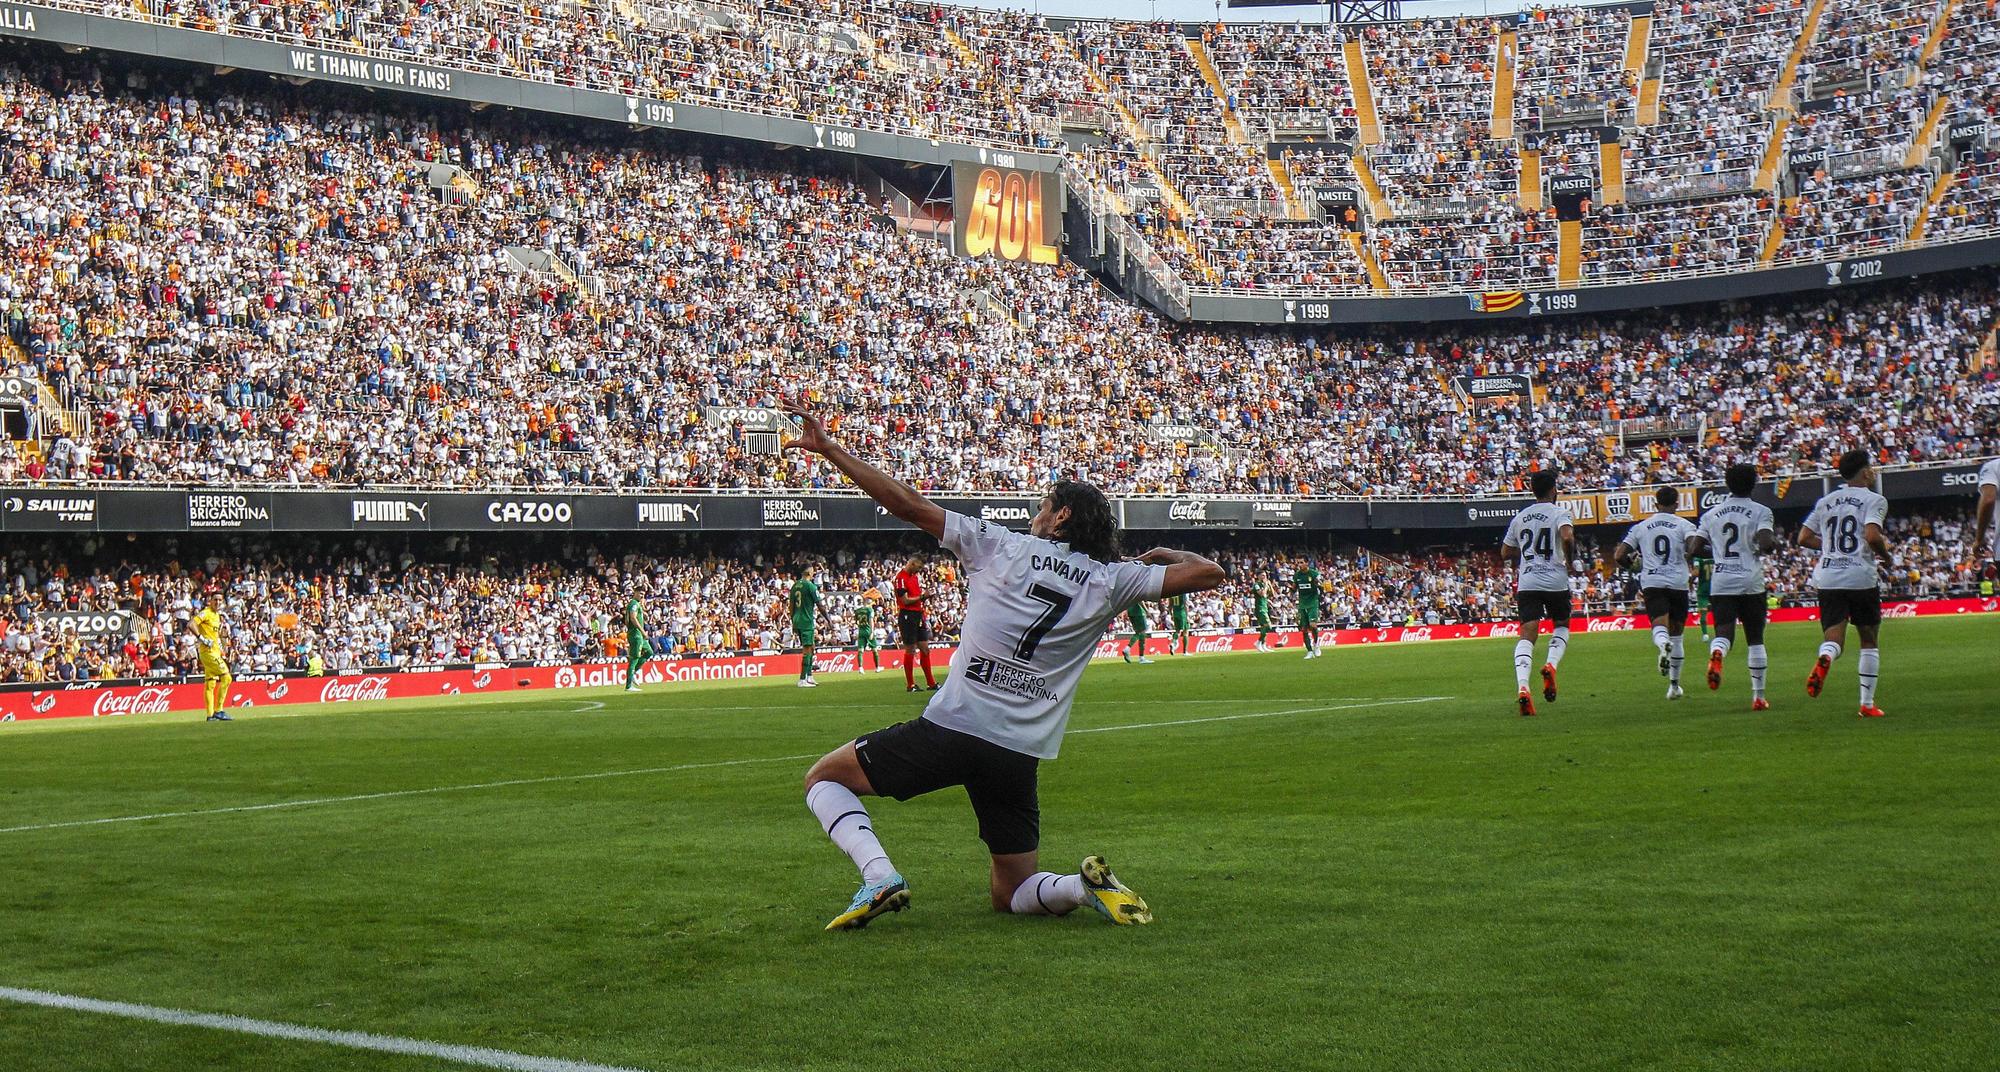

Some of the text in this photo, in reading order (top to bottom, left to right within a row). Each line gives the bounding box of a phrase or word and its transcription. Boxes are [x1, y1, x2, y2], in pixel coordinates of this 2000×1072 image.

[291, 51, 451, 91] WE THANK OUR FANS!
[645, 104, 674, 123] 1979
[830, 130, 856, 148] 1980
[1950, 124, 1985, 138] AMSTE
[992, 153, 1015, 168] 1980
[1790, 150, 1826, 164] AMSTE
[1127, 187, 1160, 198] AMSTEL
[1552, 178, 1591, 190] AMSTEL
[1317, 192, 1353, 201] AMSTEL
[965, 168, 1058, 265] GOL
[1850, 260, 1882, 279] 2002
[1545, 294, 1577, 310] 1999
[1301, 304, 1329, 319] 1999
[719, 409, 768, 422] CAZOO
[1158, 426, 1194, 438] CAZOO
[1942, 472, 1979, 486] ŠKO
[27, 499, 95, 512] SAILUN
[189, 495, 247, 508] HERRERO
[353, 500, 407, 521] PUMA
[763, 500, 803, 510] HERRERO
[1169, 500, 1207, 520] Coca-Cola
[1262, 502, 1292, 511] SAILUN
[58, 512, 94, 521] TYRE
[190, 507, 269, 520] BRIGANTINA
[487, 502, 572, 522] CAZOO
[638, 503, 683, 522] PUMA
[763, 510, 819, 520] BRIGANTINA
[981, 505, 1031, 520] ŠKODA
[1722, 522, 1740, 559] 2
[1827, 515, 1859, 555] 18
[1520, 527, 1554, 562] 24
[1654, 534, 1671, 566] 9
[1031, 554, 1091, 586] CAVANI
[795, 590, 802, 608] 3
[1012, 582, 1074, 665] 7
[666, 659, 765, 681] Santander
[995, 663, 1046, 688] HERRERO
[320, 677, 392, 703] Coca-Cola
[992, 673, 1059, 703] BRIGANTINA
[1016, 690, 1035, 701] Broker
[93, 687, 174, 717] Coca-Cola
